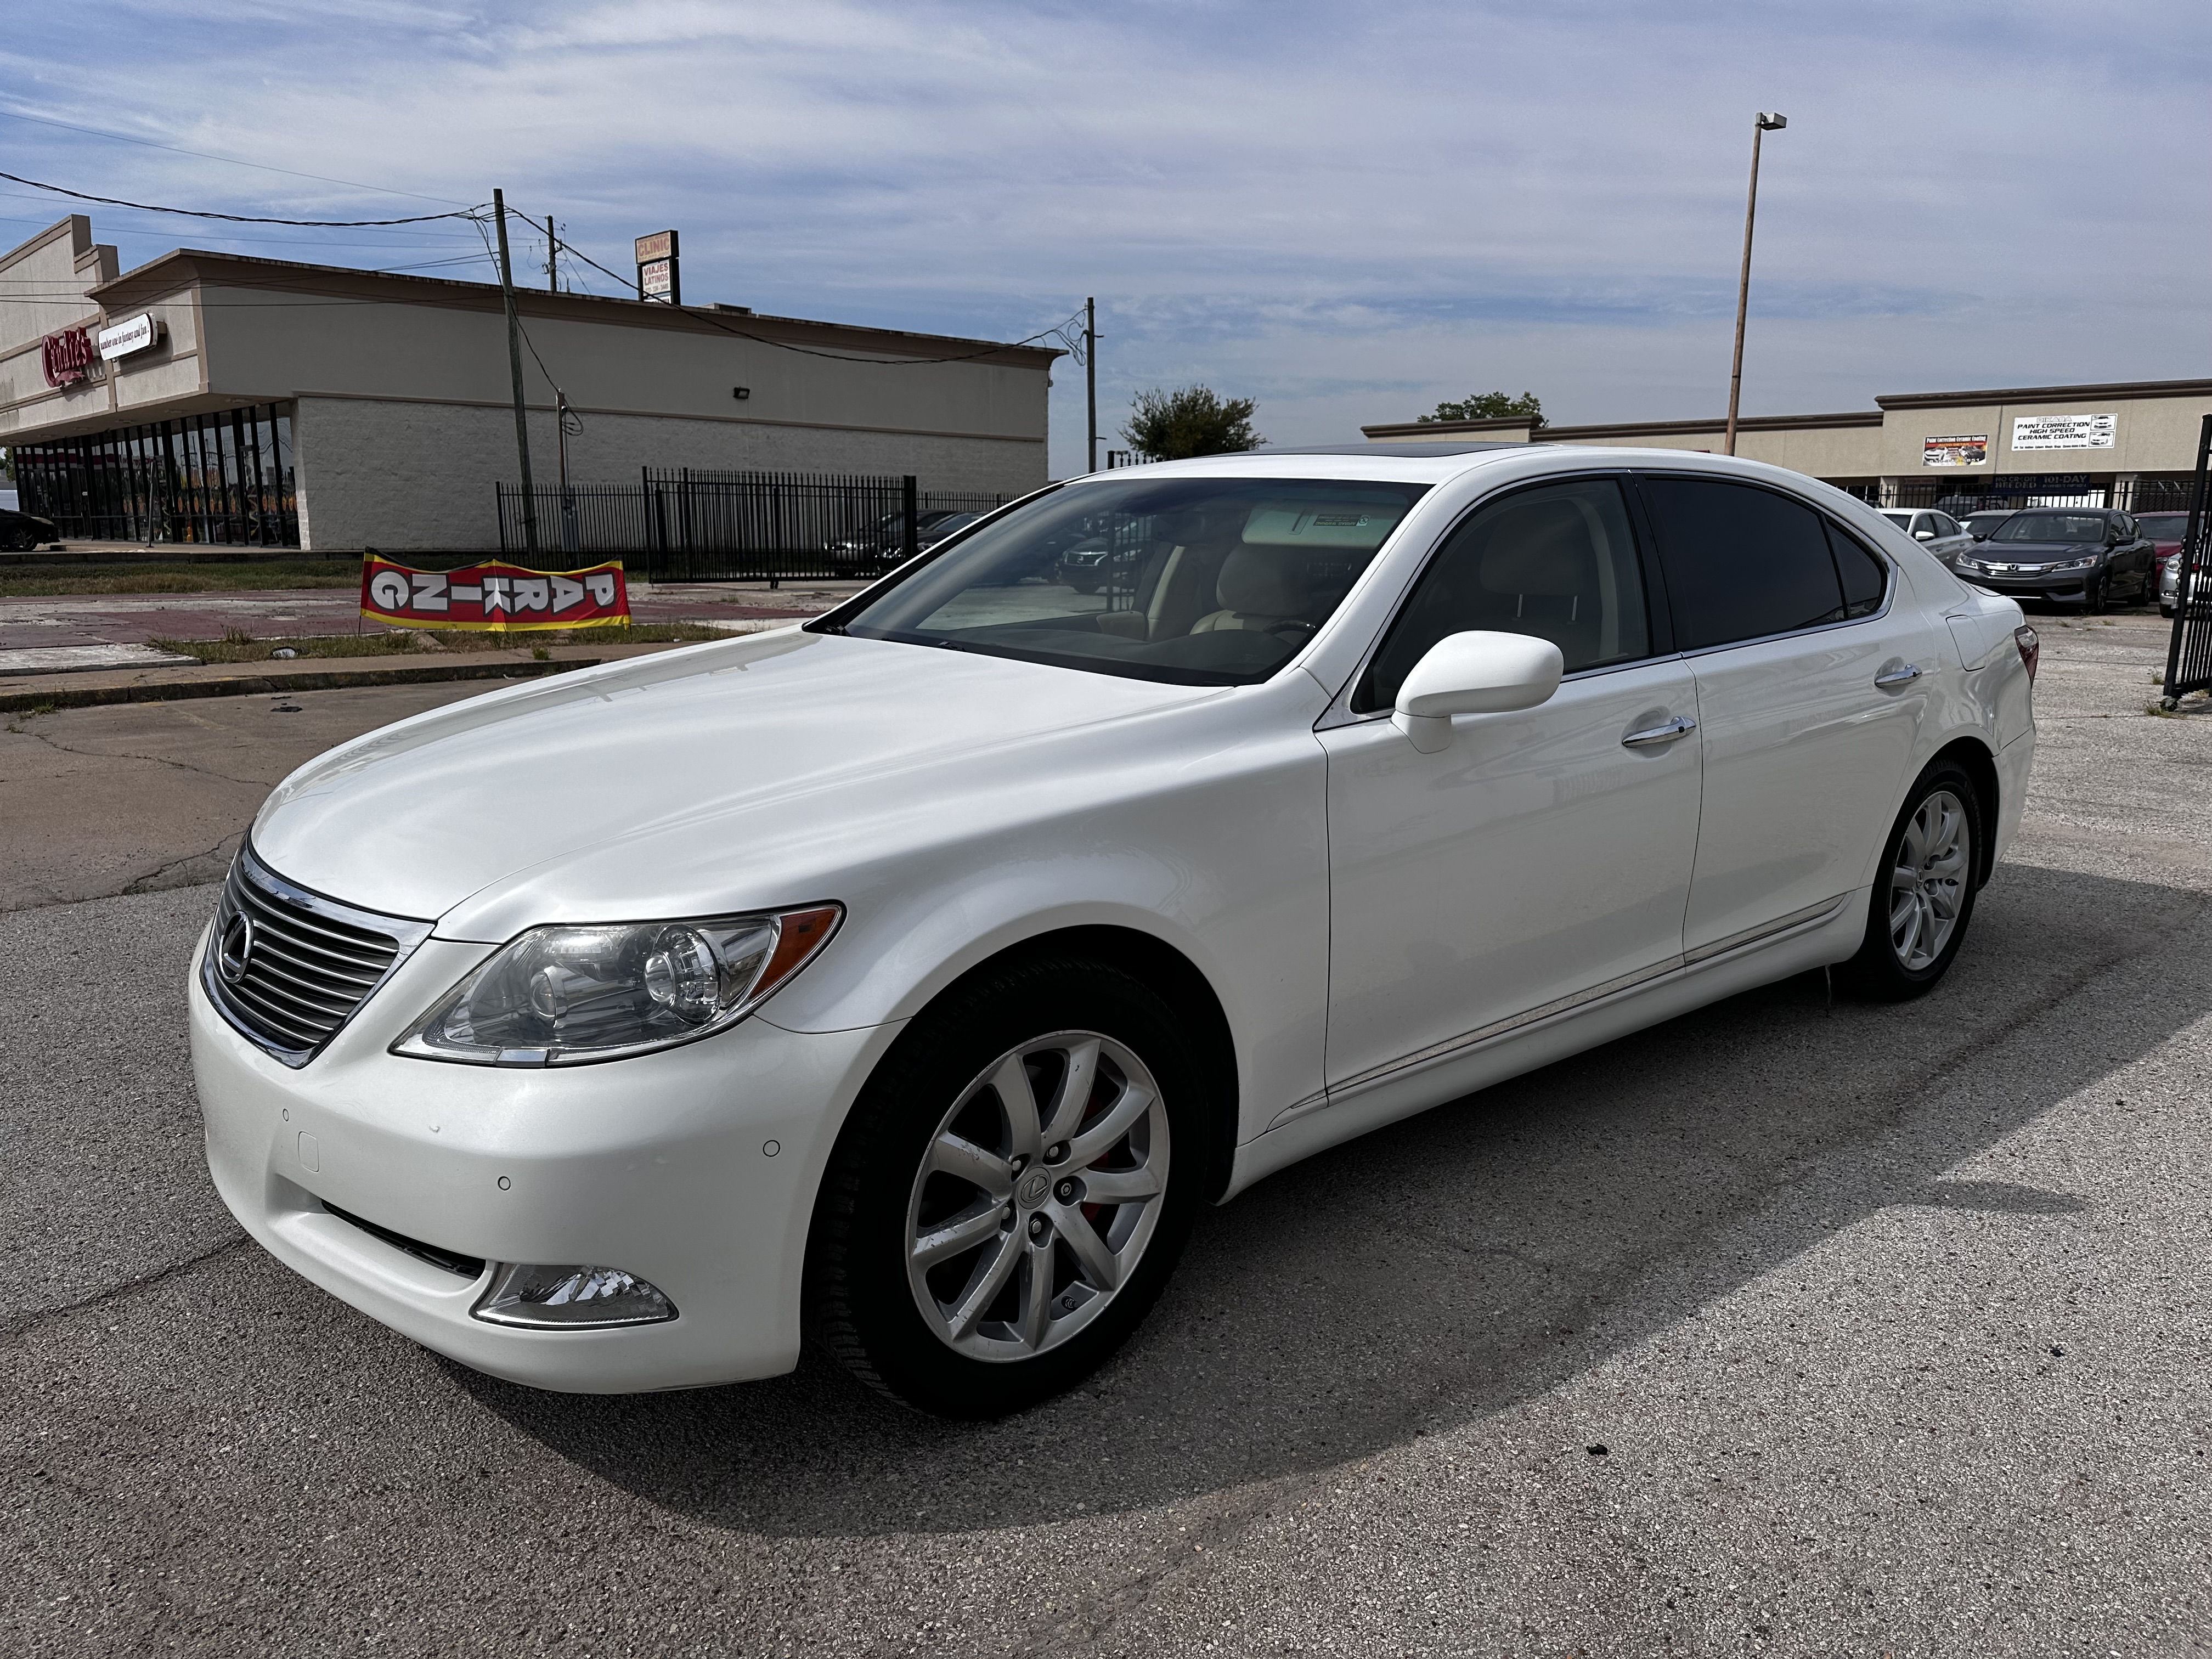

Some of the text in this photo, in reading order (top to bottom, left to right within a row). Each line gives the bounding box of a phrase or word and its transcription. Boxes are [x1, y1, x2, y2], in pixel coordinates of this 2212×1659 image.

[638, 238, 670, 256] CLINIC
[644, 263, 668, 276] VIAJES
[644, 273, 669, 286] LATINOS
[370, 571, 615, 616] PARKING
